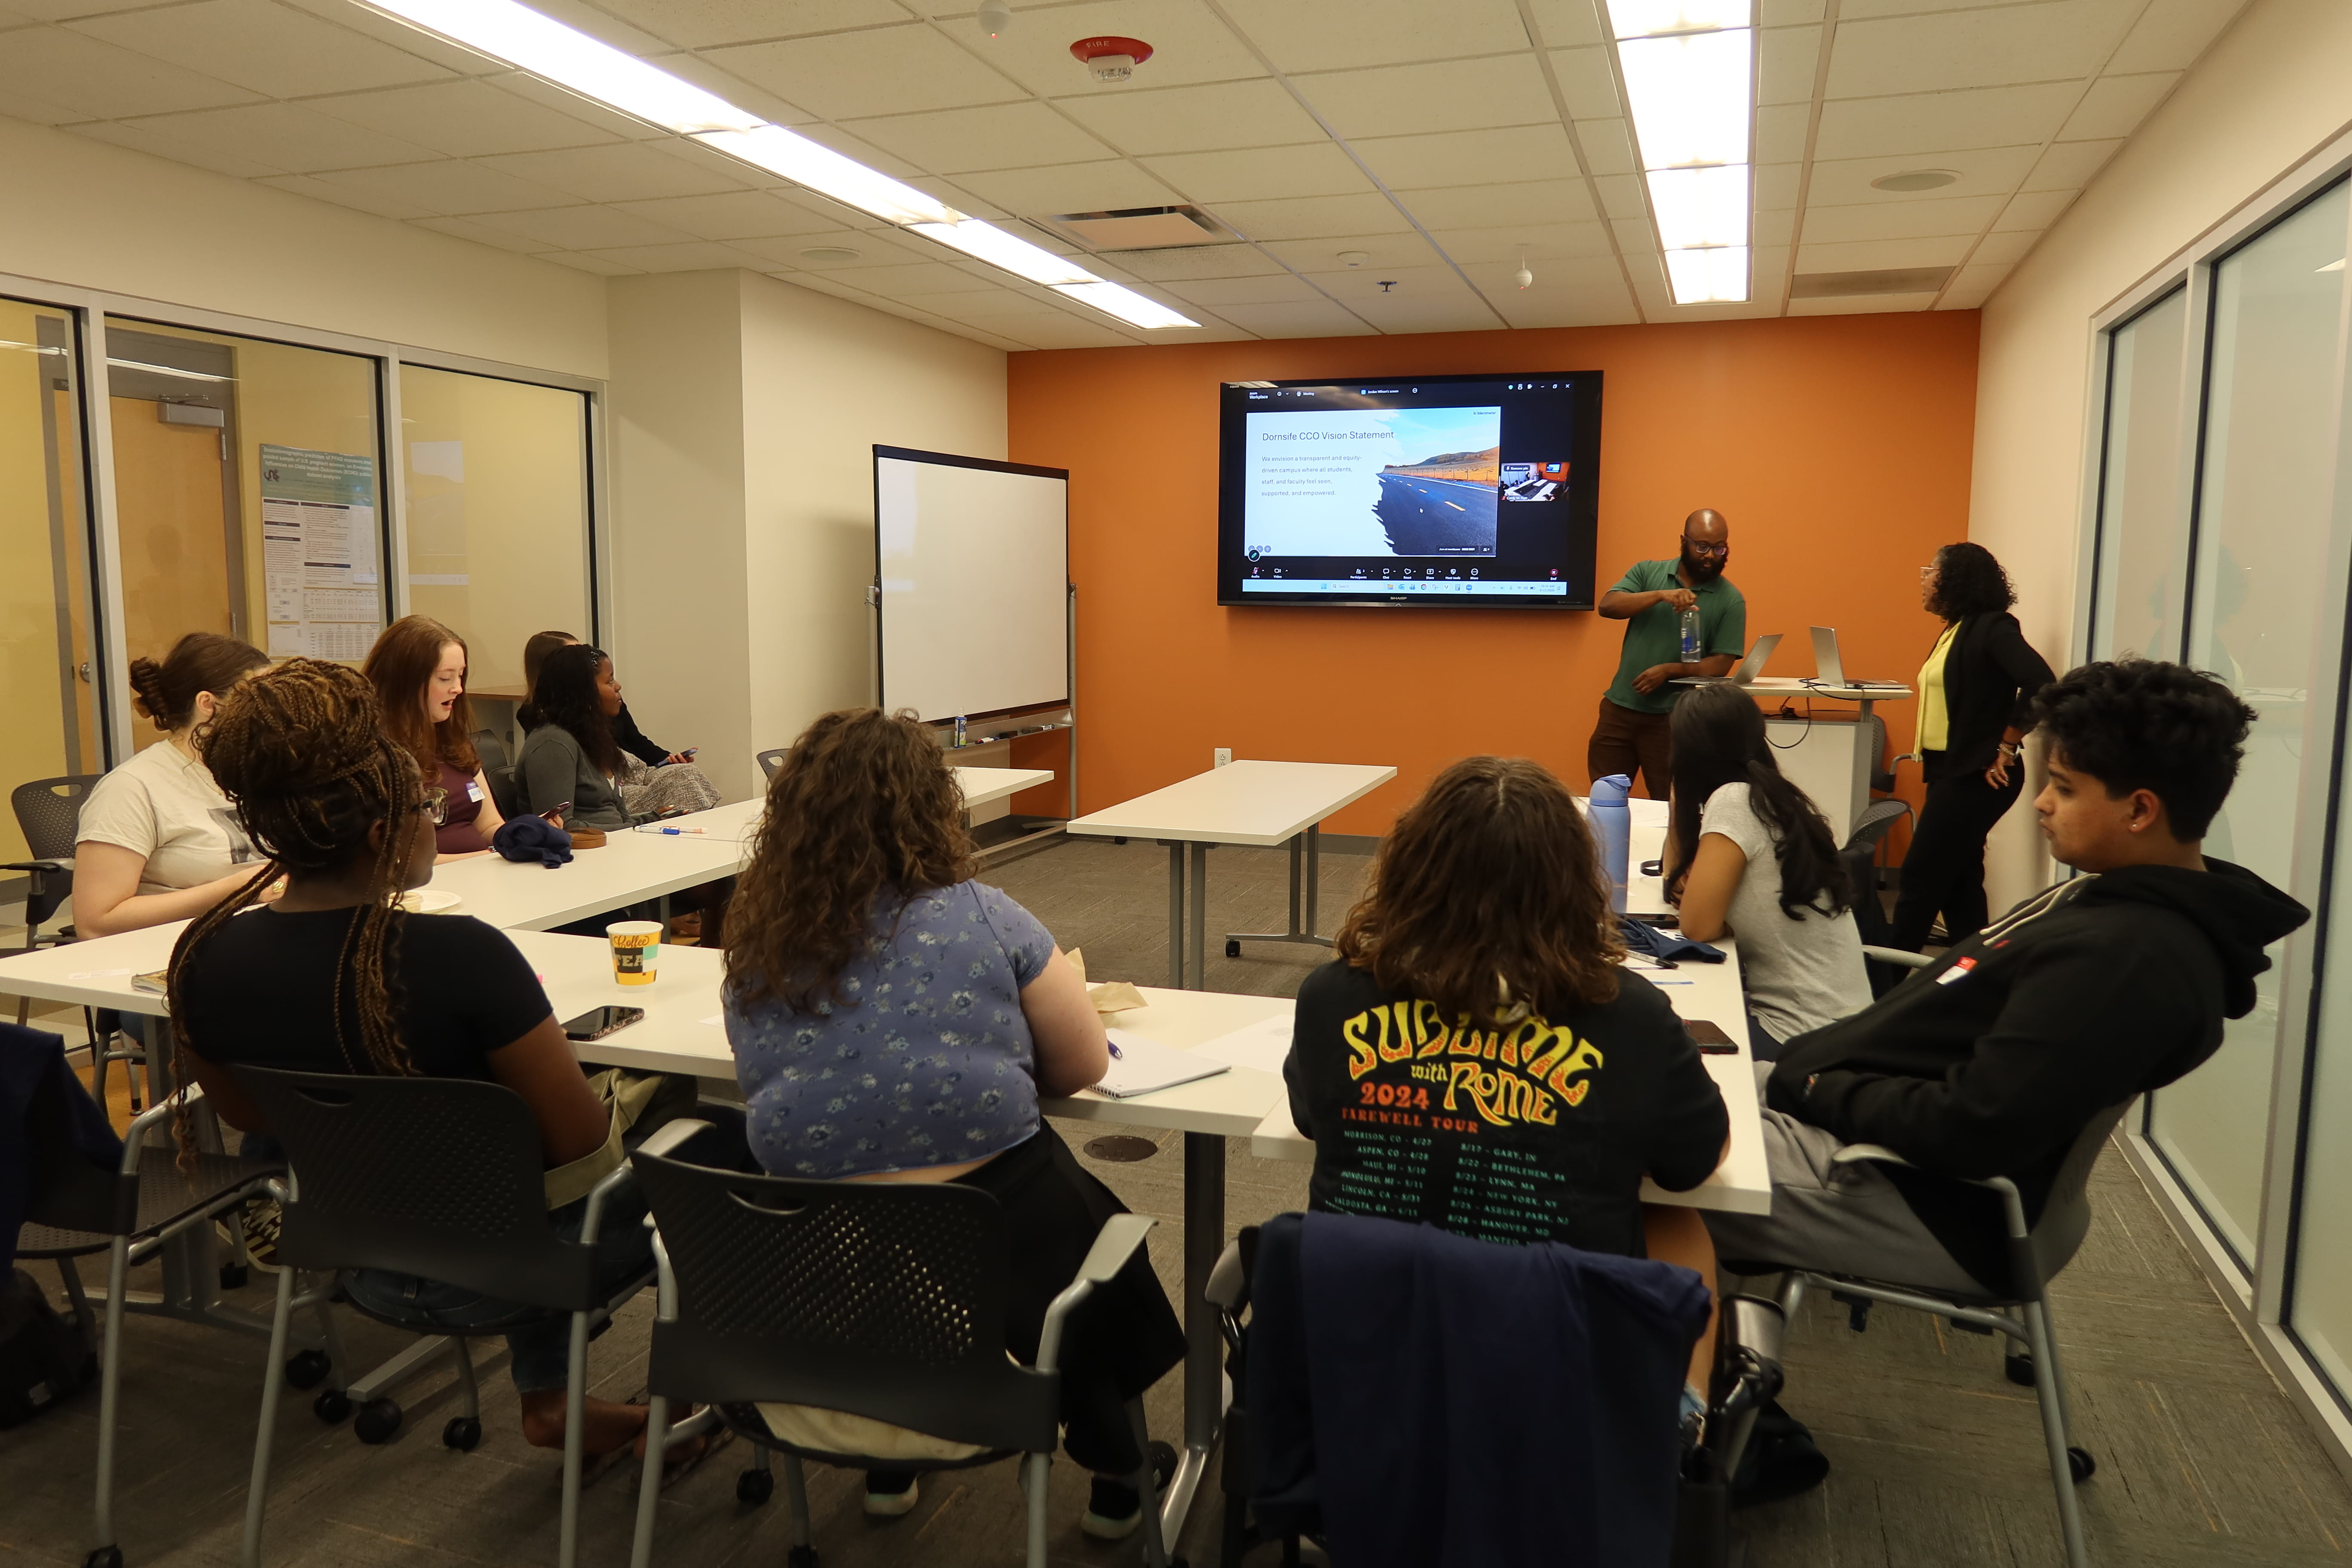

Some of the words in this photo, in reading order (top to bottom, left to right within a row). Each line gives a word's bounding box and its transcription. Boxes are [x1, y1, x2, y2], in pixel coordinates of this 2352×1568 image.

[1262, 432, 1297, 441] Dornsife
[1299, 432, 1320, 440] CCO
[1322, 432, 1347, 440] Vision
[1349, 431, 1394, 439] Statement
[614, 935, 649, 948] Coffee
[616, 954, 643, 967] TEA
[1360, 1081, 1430, 1110] 2024
[1411, 1062, 1448, 1082] with
[1443, 1062, 1558, 1126] ROME
[1342, 1107, 1422, 1127] FAREWELL
[1432, 1116, 1479, 1133] TOUR
[1387, 1148, 1400, 1157] CO
[1525, 1153, 1537, 1162] IN
[1387, 1163, 1396, 1171] HI
[1554, 1173, 1566, 1182] PA
[1521, 1182, 1535, 1191] MA
[1379, 1190, 1390, 1199] CA
[1487, 1191, 1508, 1200] NEW
[1375, 1204, 1387, 1213] GA
[1484, 1205, 1521, 1218] ASBURY
